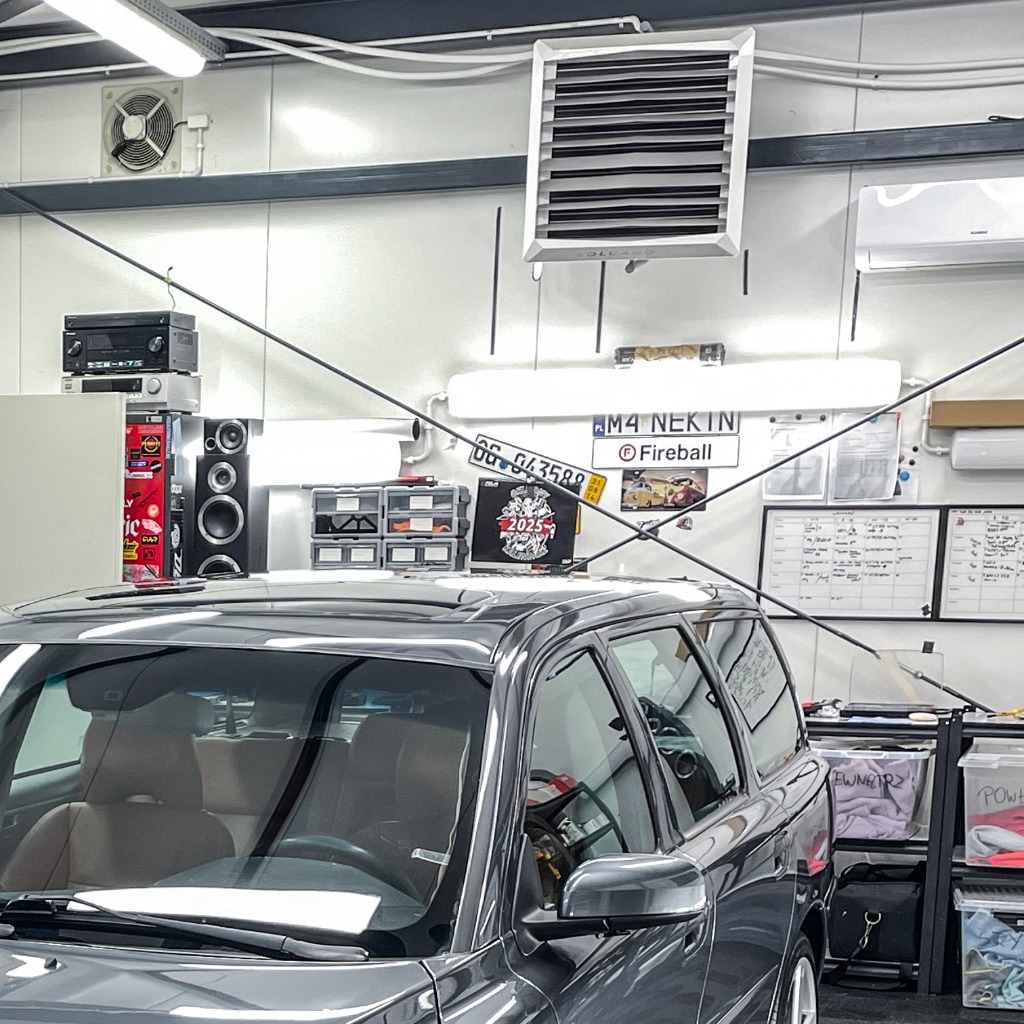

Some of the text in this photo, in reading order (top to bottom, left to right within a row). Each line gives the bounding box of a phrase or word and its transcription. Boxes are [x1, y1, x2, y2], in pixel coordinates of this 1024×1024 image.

[595, 424, 604, 432] PL
[607, 413, 639, 433] M4
[640, 443, 712, 461] Fireball
[507, 518, 544, 532] 2025
